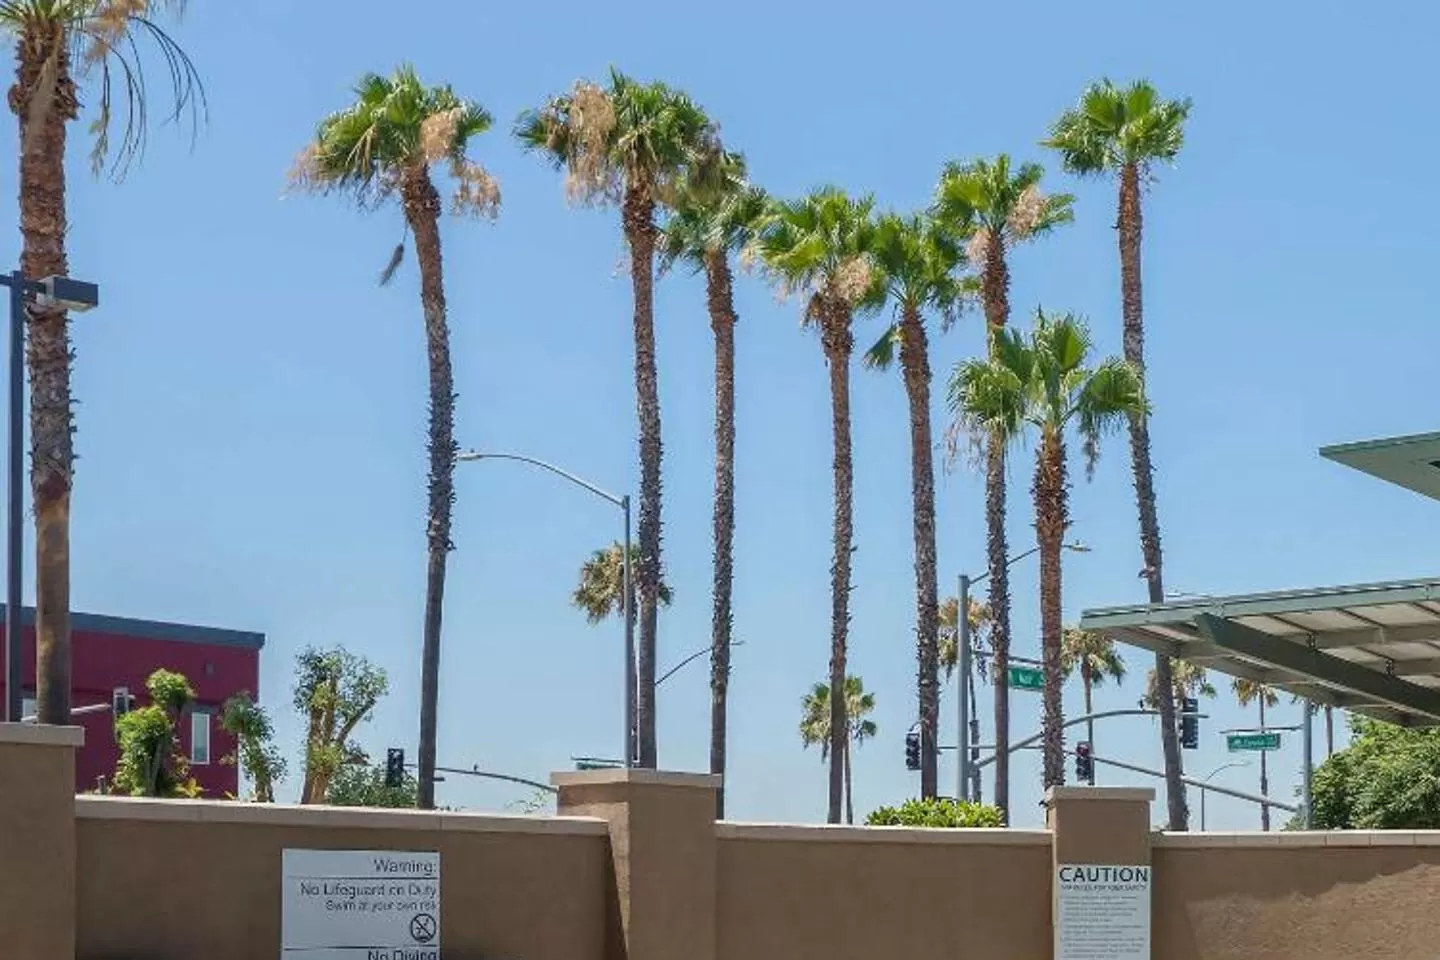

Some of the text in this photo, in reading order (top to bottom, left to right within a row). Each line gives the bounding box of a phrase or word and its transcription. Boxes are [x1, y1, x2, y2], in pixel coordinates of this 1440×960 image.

[1059, 867, 1149, 882] CAUTION
[300, 882, 320, 896] No
[323, 883, 385, 899] Lifeguard
